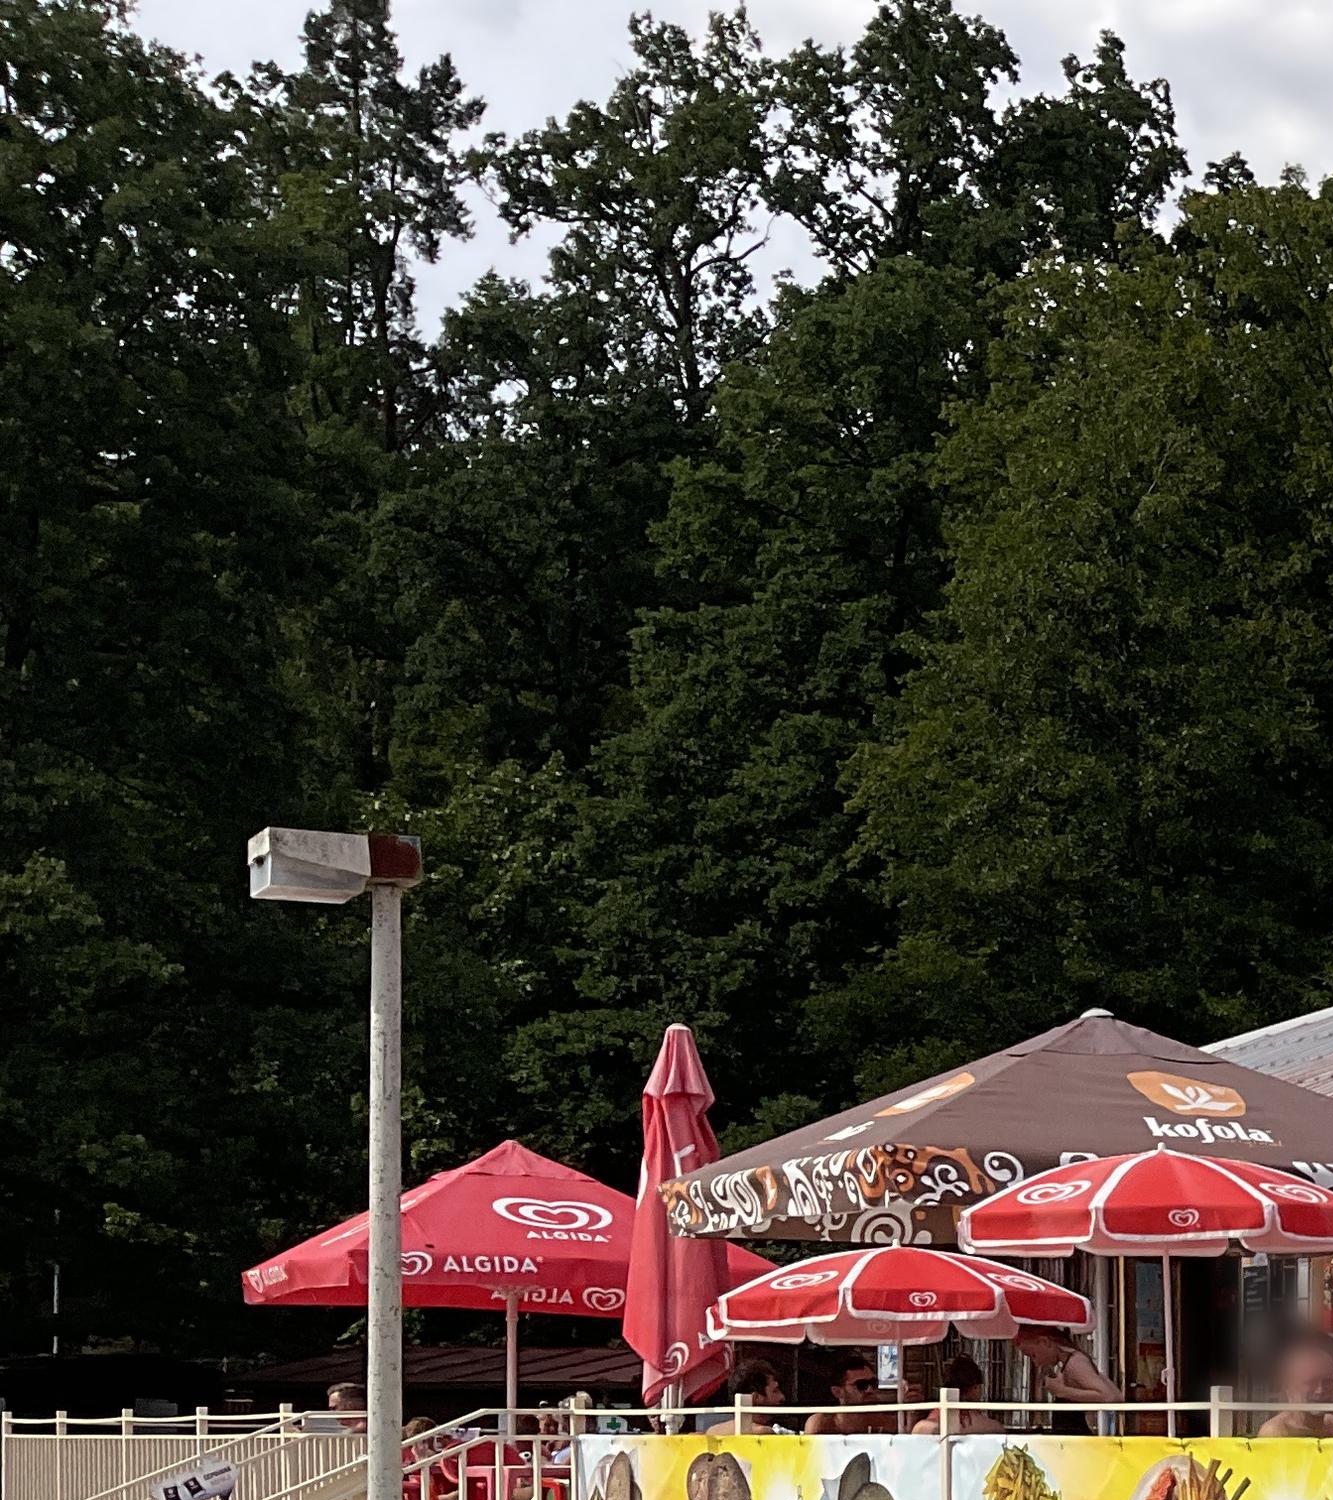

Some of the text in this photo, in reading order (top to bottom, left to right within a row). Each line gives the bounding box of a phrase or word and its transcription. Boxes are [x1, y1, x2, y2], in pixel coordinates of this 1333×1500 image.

[1143, 1116, 1274, 1144] kofola
[527, 1230, 610, 1243] ALGIDA
[443, 1256, 539, 1274] ALGIDA
